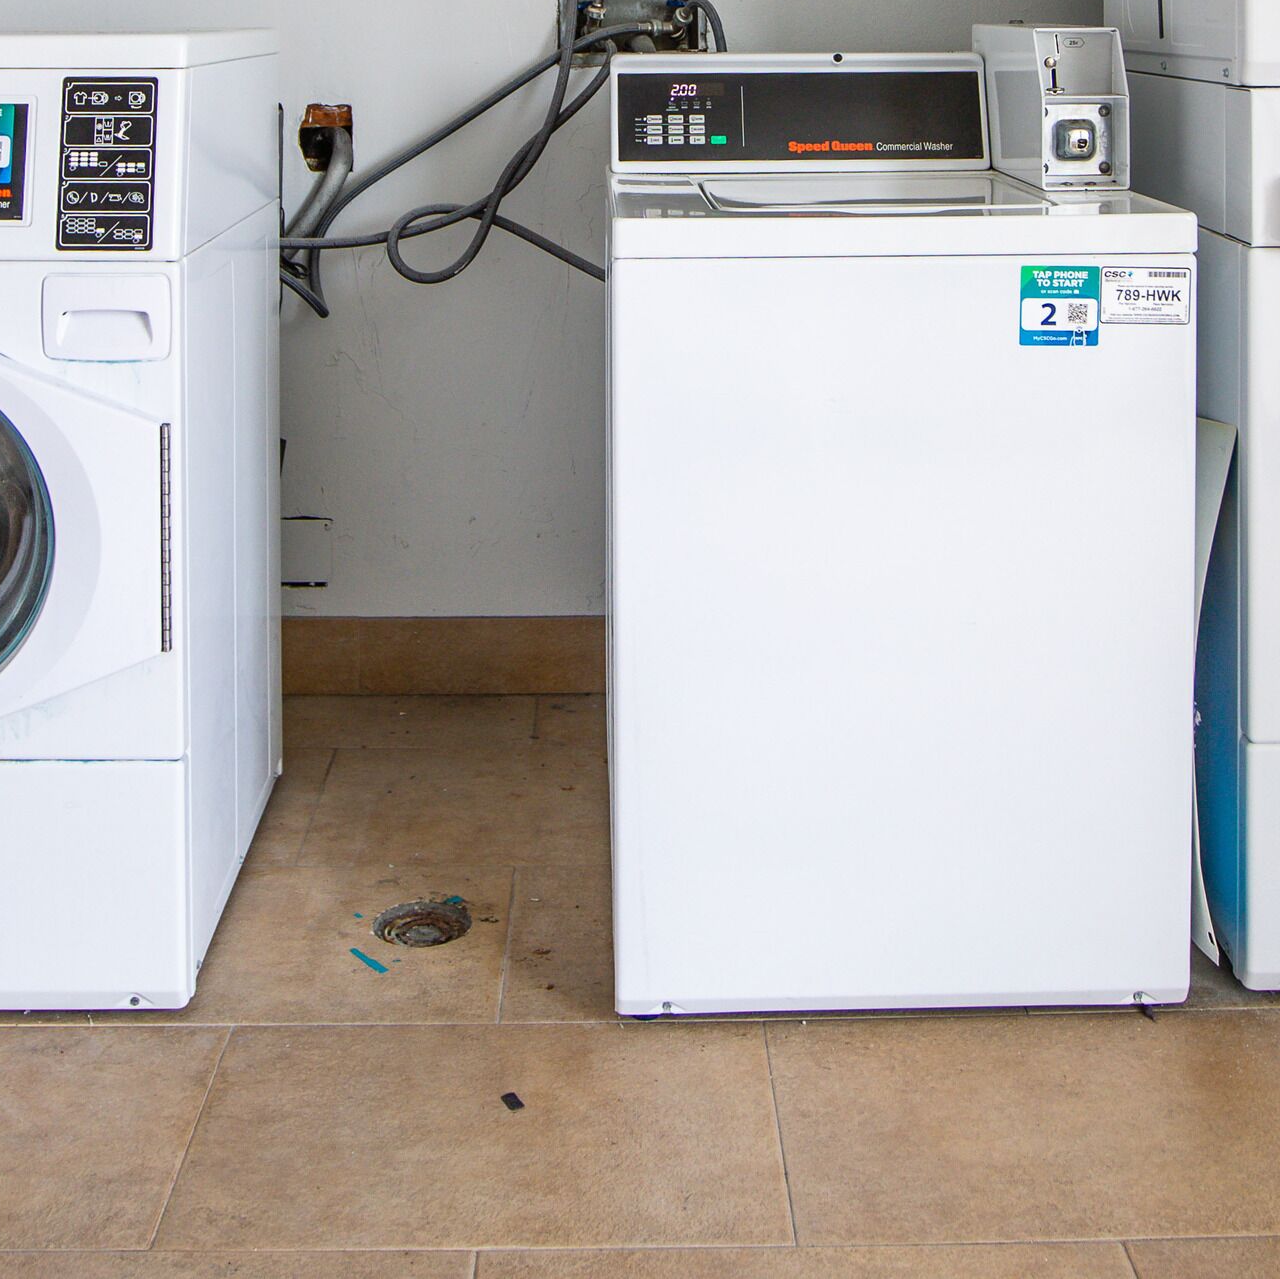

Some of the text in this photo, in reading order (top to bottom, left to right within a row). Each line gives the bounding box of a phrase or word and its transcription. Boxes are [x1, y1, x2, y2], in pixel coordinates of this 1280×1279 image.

[670, 84, 697, 96] 2.00
[788, 141, 873, 153] Speed Queen
[876, 142, 953, 151] Commercial Washer
[1054, 271, 1088, 279] PHONE
[1037, 279, 1084, 287] TO START
[1116, 289, 1181, 301] 789-HWK
[1040, 303, 1056, 325] 2
